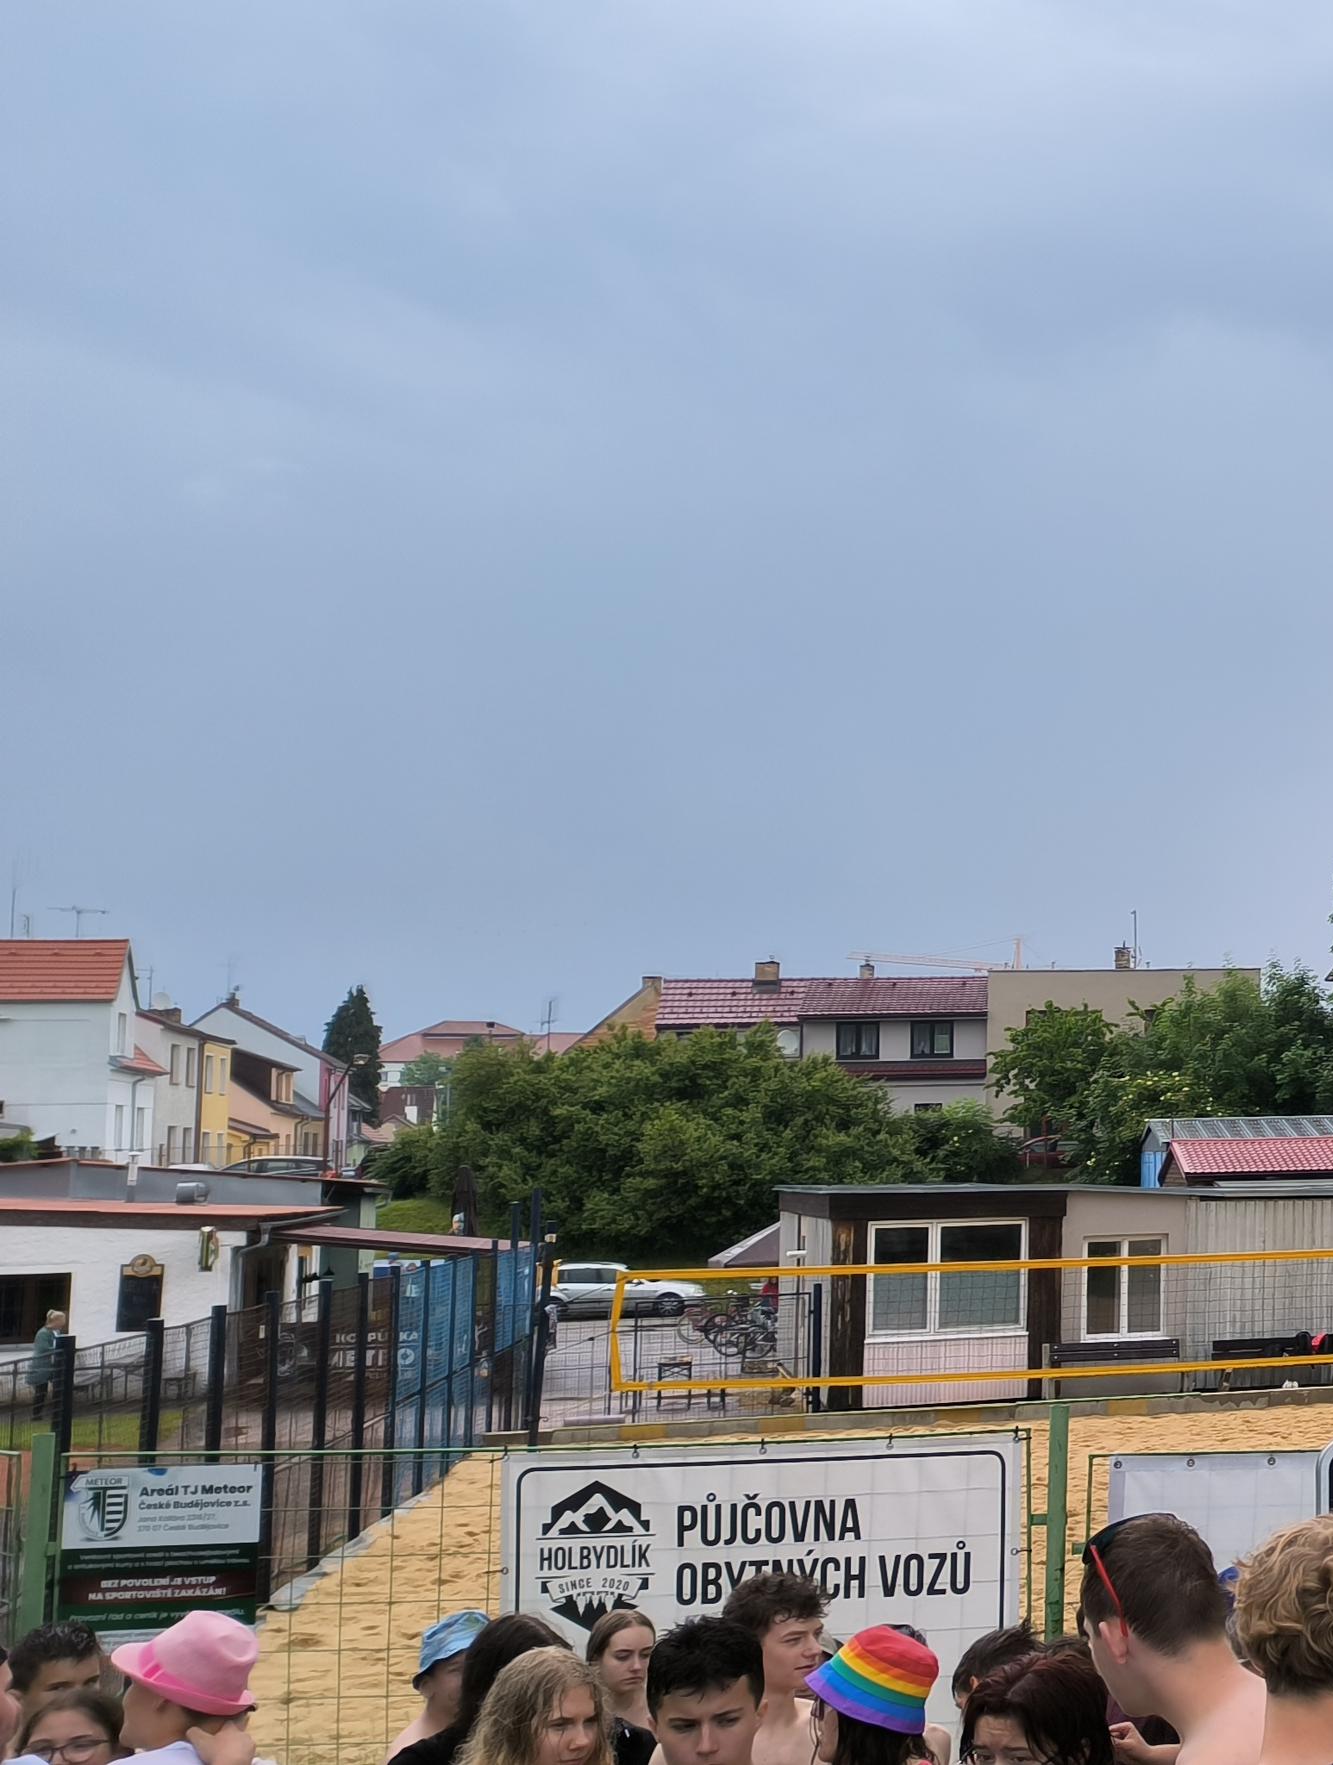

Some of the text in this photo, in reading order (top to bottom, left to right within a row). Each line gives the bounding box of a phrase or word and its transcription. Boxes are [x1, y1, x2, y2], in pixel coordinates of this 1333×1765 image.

[139, 1484, 253, 1497] Areál TJ Meteor
[138, 1501, 171, 1511] České
[173, 1499, 232, 1510] Budějovice
[677, 1492, 862, 1548] PŮJČOVNA
[539, 1539, 651, 1571] HOLBYDLÍK
[878, 1540, 971, 1598] VOZŮ
[184, 1576, 216, 1585] VSTUP
[558, 1577, 630, 1594] SINCE 2020
